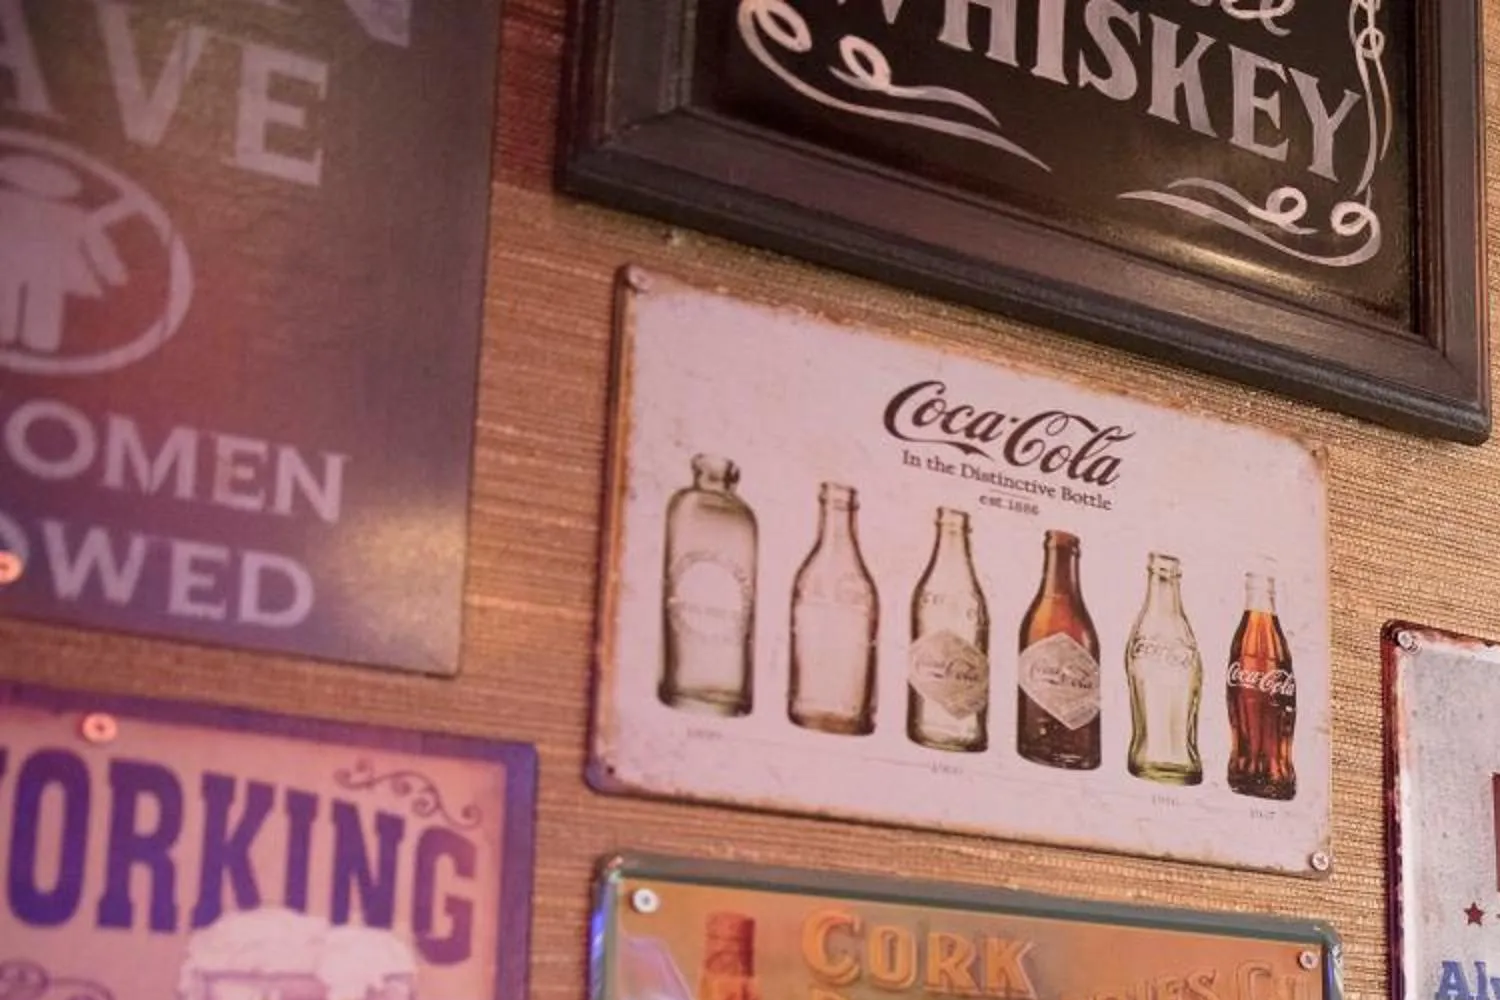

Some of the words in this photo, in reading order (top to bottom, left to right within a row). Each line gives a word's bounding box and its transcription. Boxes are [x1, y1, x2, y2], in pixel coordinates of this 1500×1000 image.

[838, 0, 1360, 183] HISKEY
[901, 449, 921, 468] In
[927, 453, 956, 477] the
[961, 463, 1057, 499] Distinctive
[1061, 485, 1113, 511] Bottle
[0, 742, 475, 965] ORKING
[801, 908, 1036, 1000] CORK
